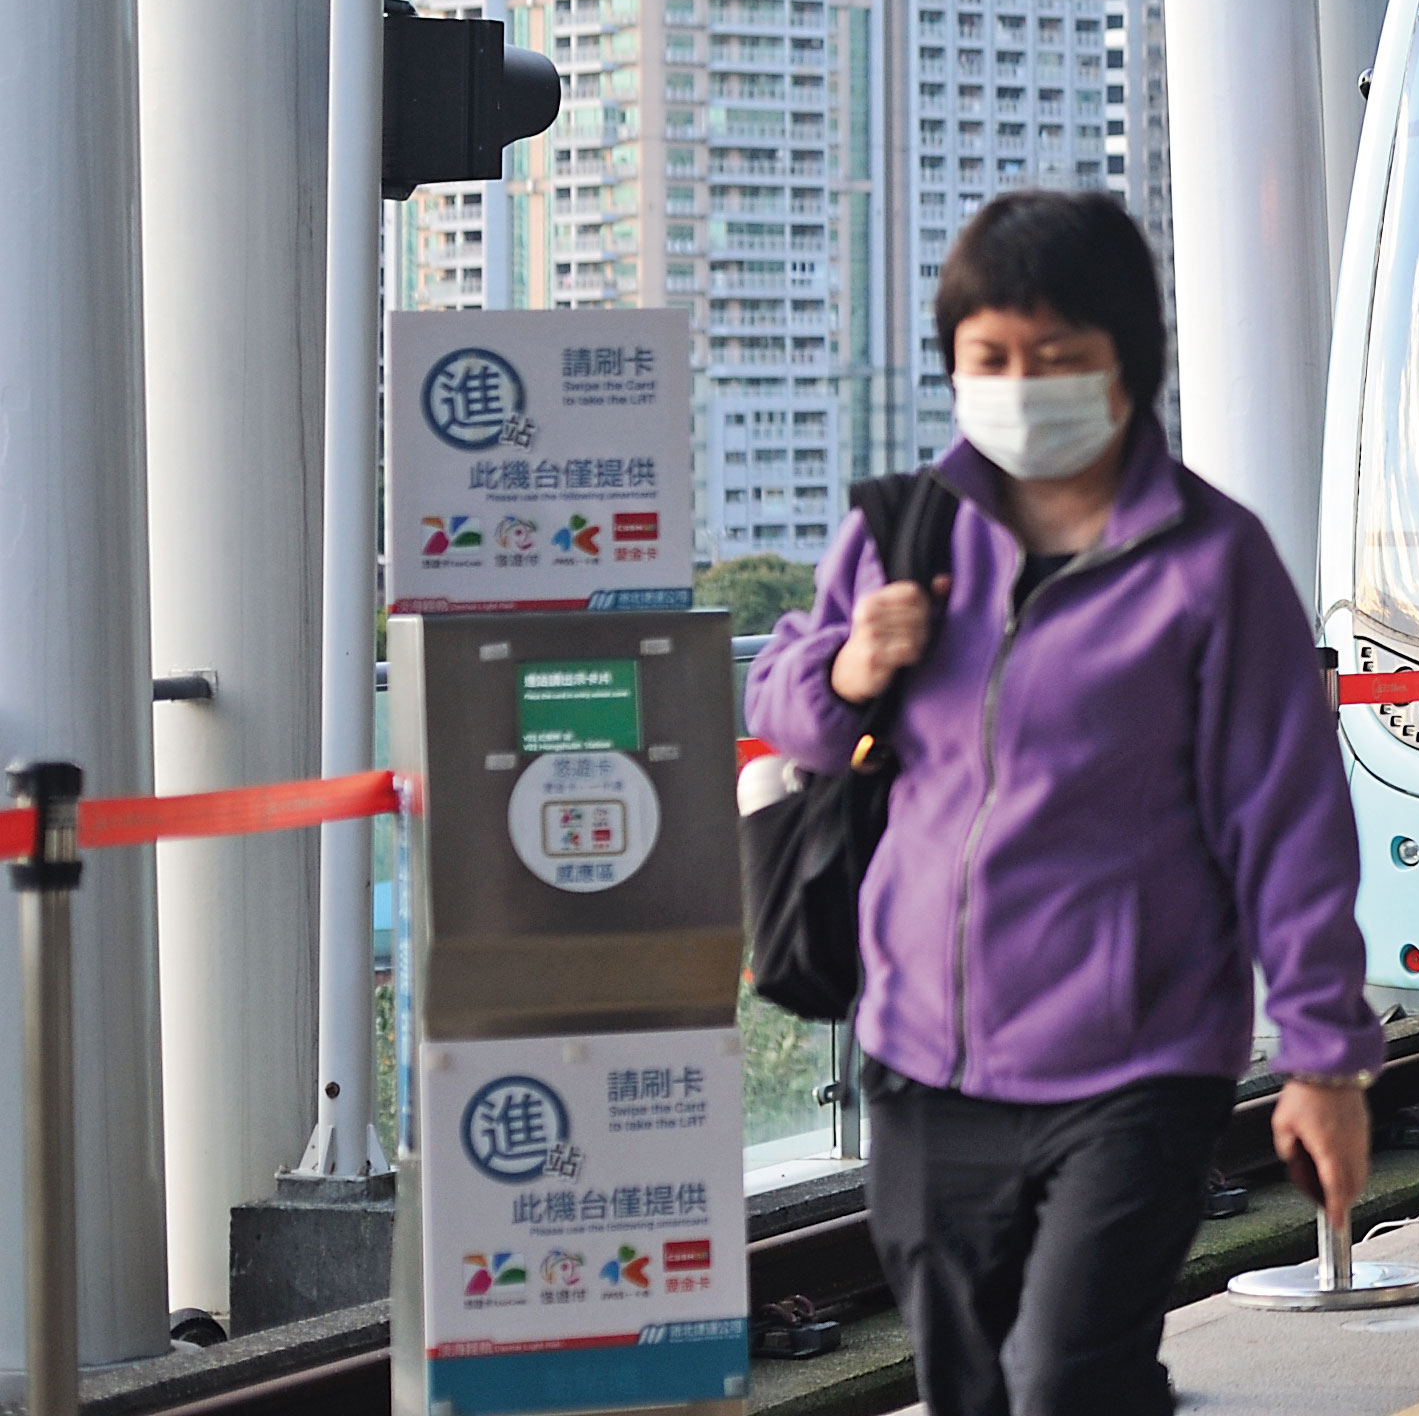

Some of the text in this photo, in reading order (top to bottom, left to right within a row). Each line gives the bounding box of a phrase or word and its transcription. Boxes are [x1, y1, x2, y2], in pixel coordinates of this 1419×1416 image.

[562, 346, 654, 377] 請刷卡
[467, 457, 658, 491] 此機台僅提供
[607, 1067, 703, 1101] 請刷卡
[609, 1107, 647, 1117] Swipe
[675, 1102, 705, 1114] Card
[511, 1182, 706, 1225] 此機台僅提供
